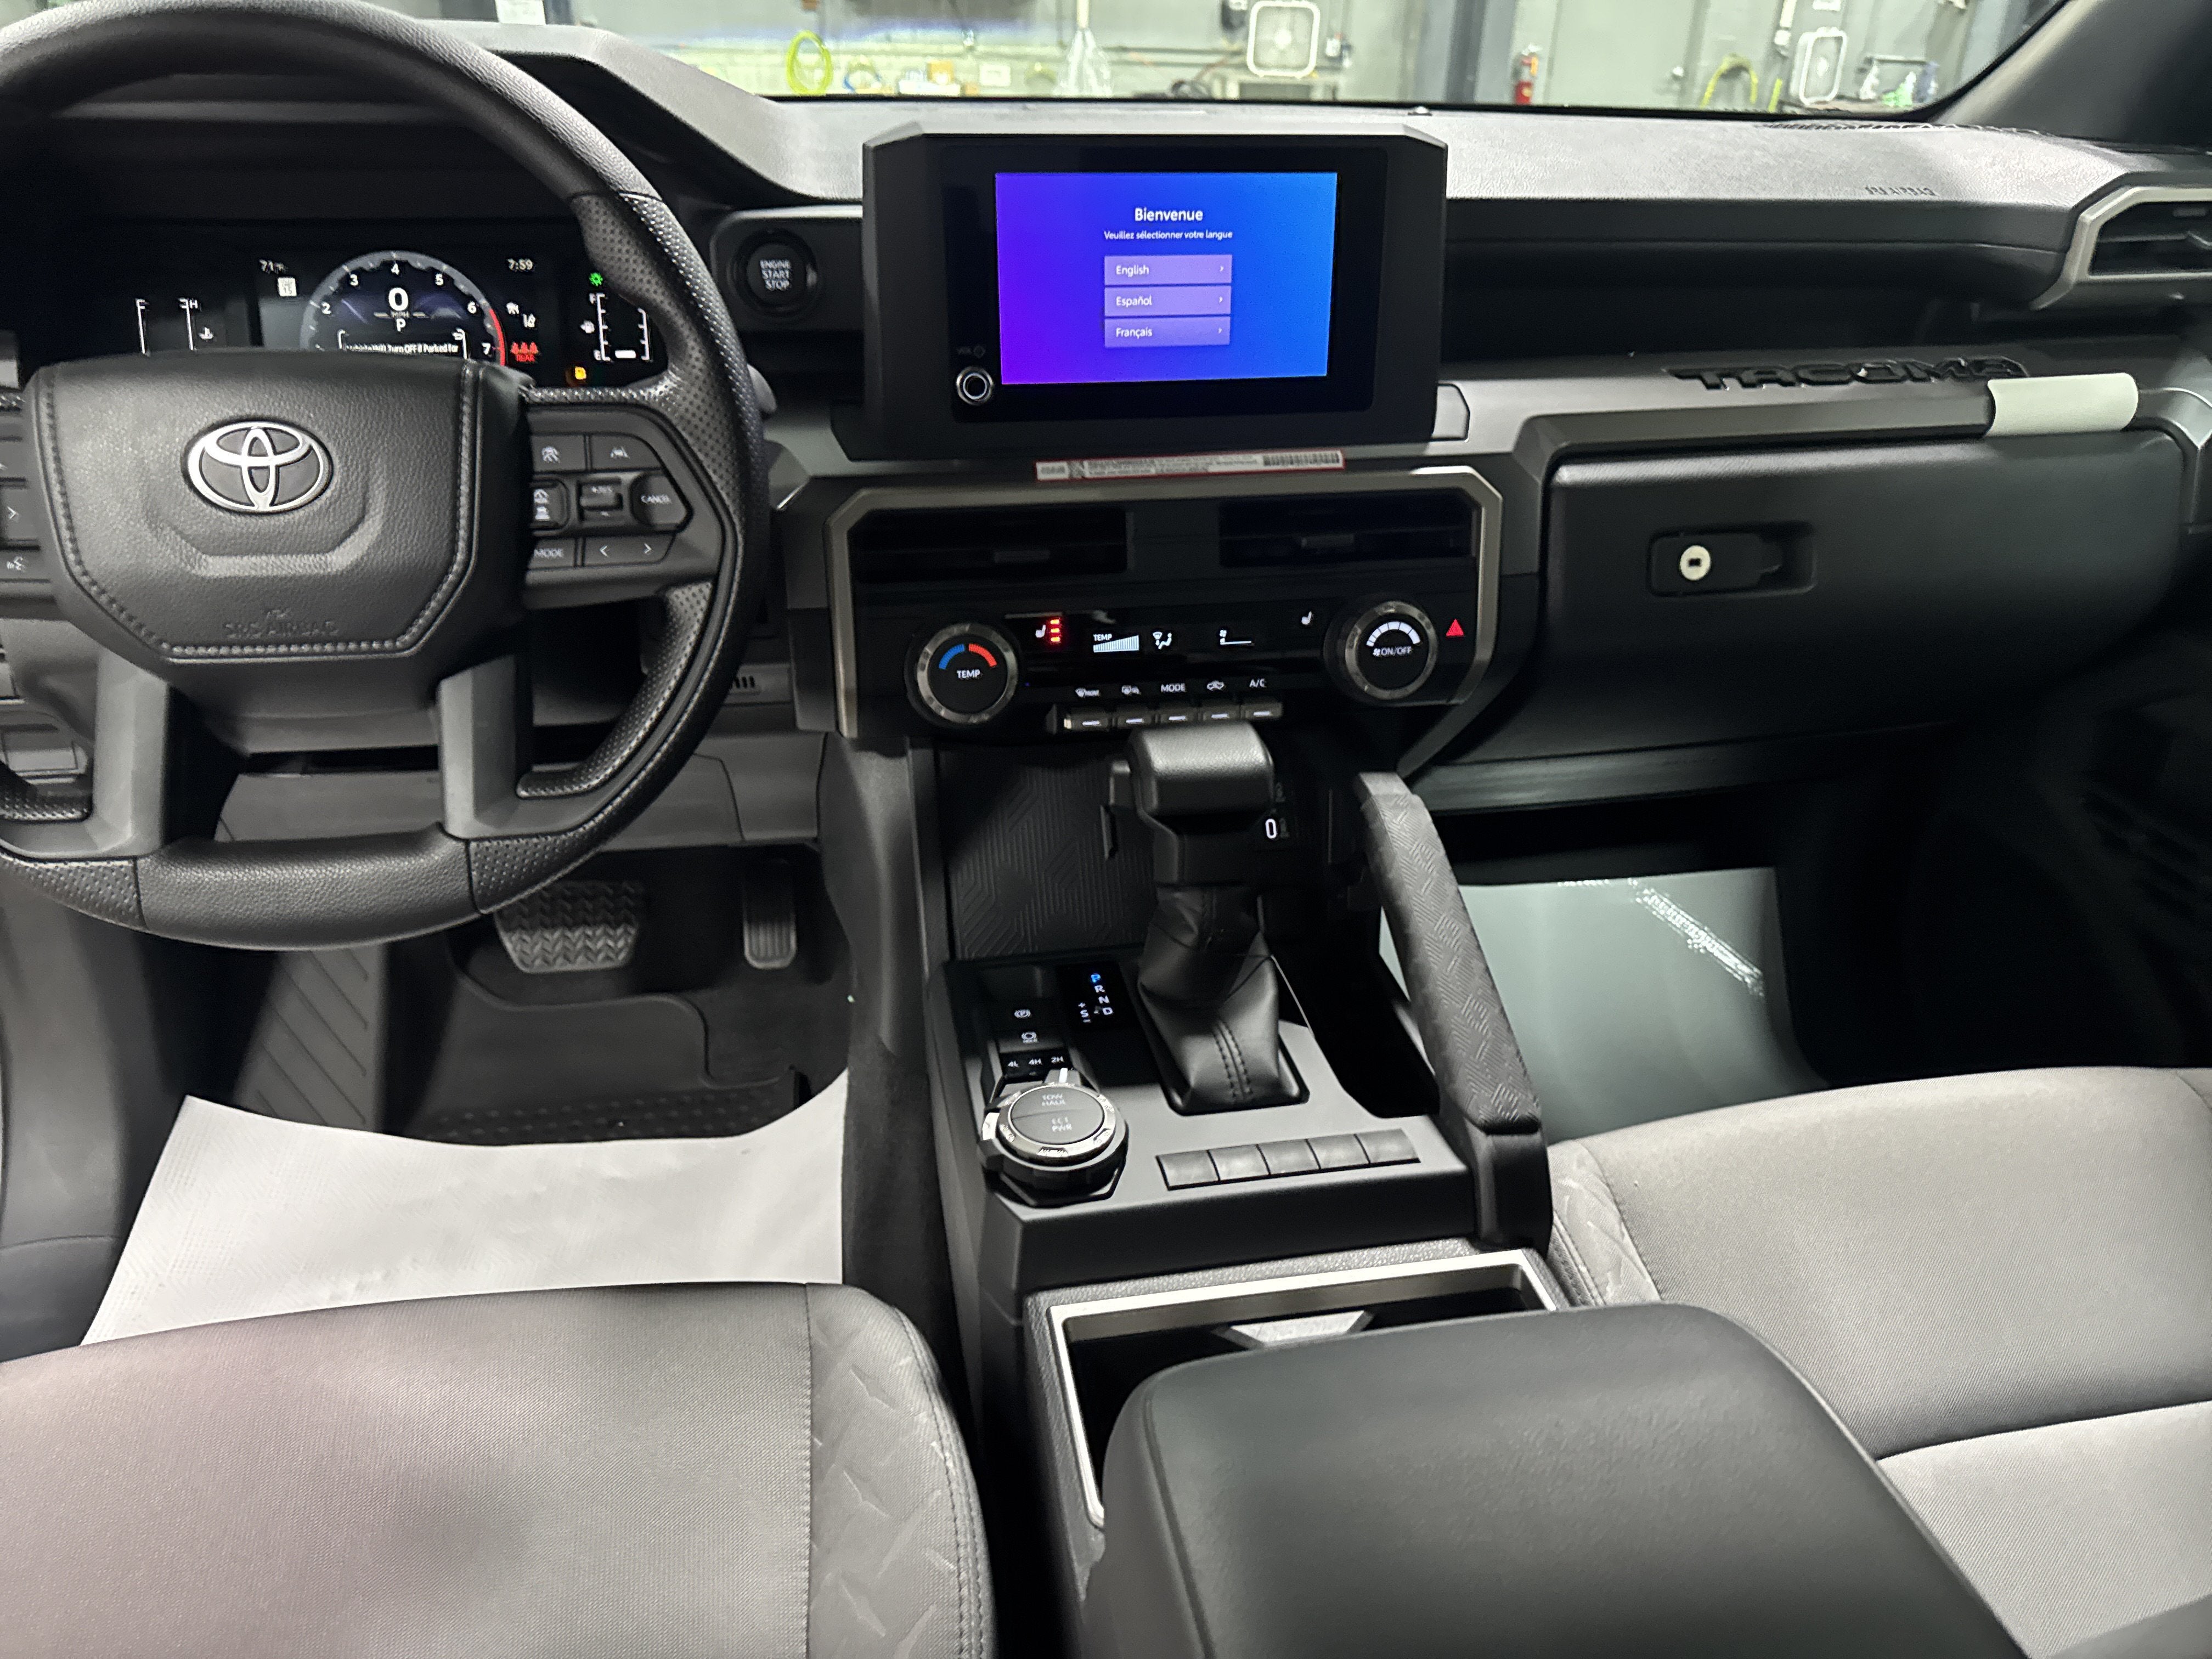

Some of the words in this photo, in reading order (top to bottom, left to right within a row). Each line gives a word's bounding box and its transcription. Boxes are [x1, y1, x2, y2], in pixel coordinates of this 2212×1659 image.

[1135, 206, 1204, 222] Bienvenue
[1104, 230, 1135, 240] Veuillez
[1136, 230, 1183, 240] sélectionner
[1184, 230, 1204, 239] votre
[1205, 229, 1233, 240] langue
[391, 263, 400, 275] 4
[507, 258, 534, 271] 7:59
[760, 259, 791, 270] ENGINE
[1115, 264, 1149, 277] English
[349, 274, 358, 286] 3
[435, 274, 443, 286] 5
[762, 269, 790, 279] START
[765, 279, 790, 291] STOP
[388, 287, 409, 312] 0
[1115, 295, 1152, 307] Español
[322, 302, 330, 315] 2
[467, 301, 476, 314] 6
[396, 318, 406, 331] P
[1115, 327, 1152, 339] Français
[404, 344, 416, 353] OFF
[424, 344, 448, 353] Parked
[482, 342, 491, 355] 7
[1093, 633, 1112, 642] TEMP
[1380, 646, 1413, 657] ON/OFF
[956, 669, 981, 680] TEMP
[1160, 682, 1187, 693] MODE
[1249, 678, 1267, 689] A/C
[1091, 973, 1101, 983] P
[1094, 985, 1105, 994] R
[1098, 995, 1110, 1005] N
[1080, 1009, 1090, 1018] S
[1102, 1006, 1114, 1016] D
[1051, 1055, 1064, 1063] 2H
